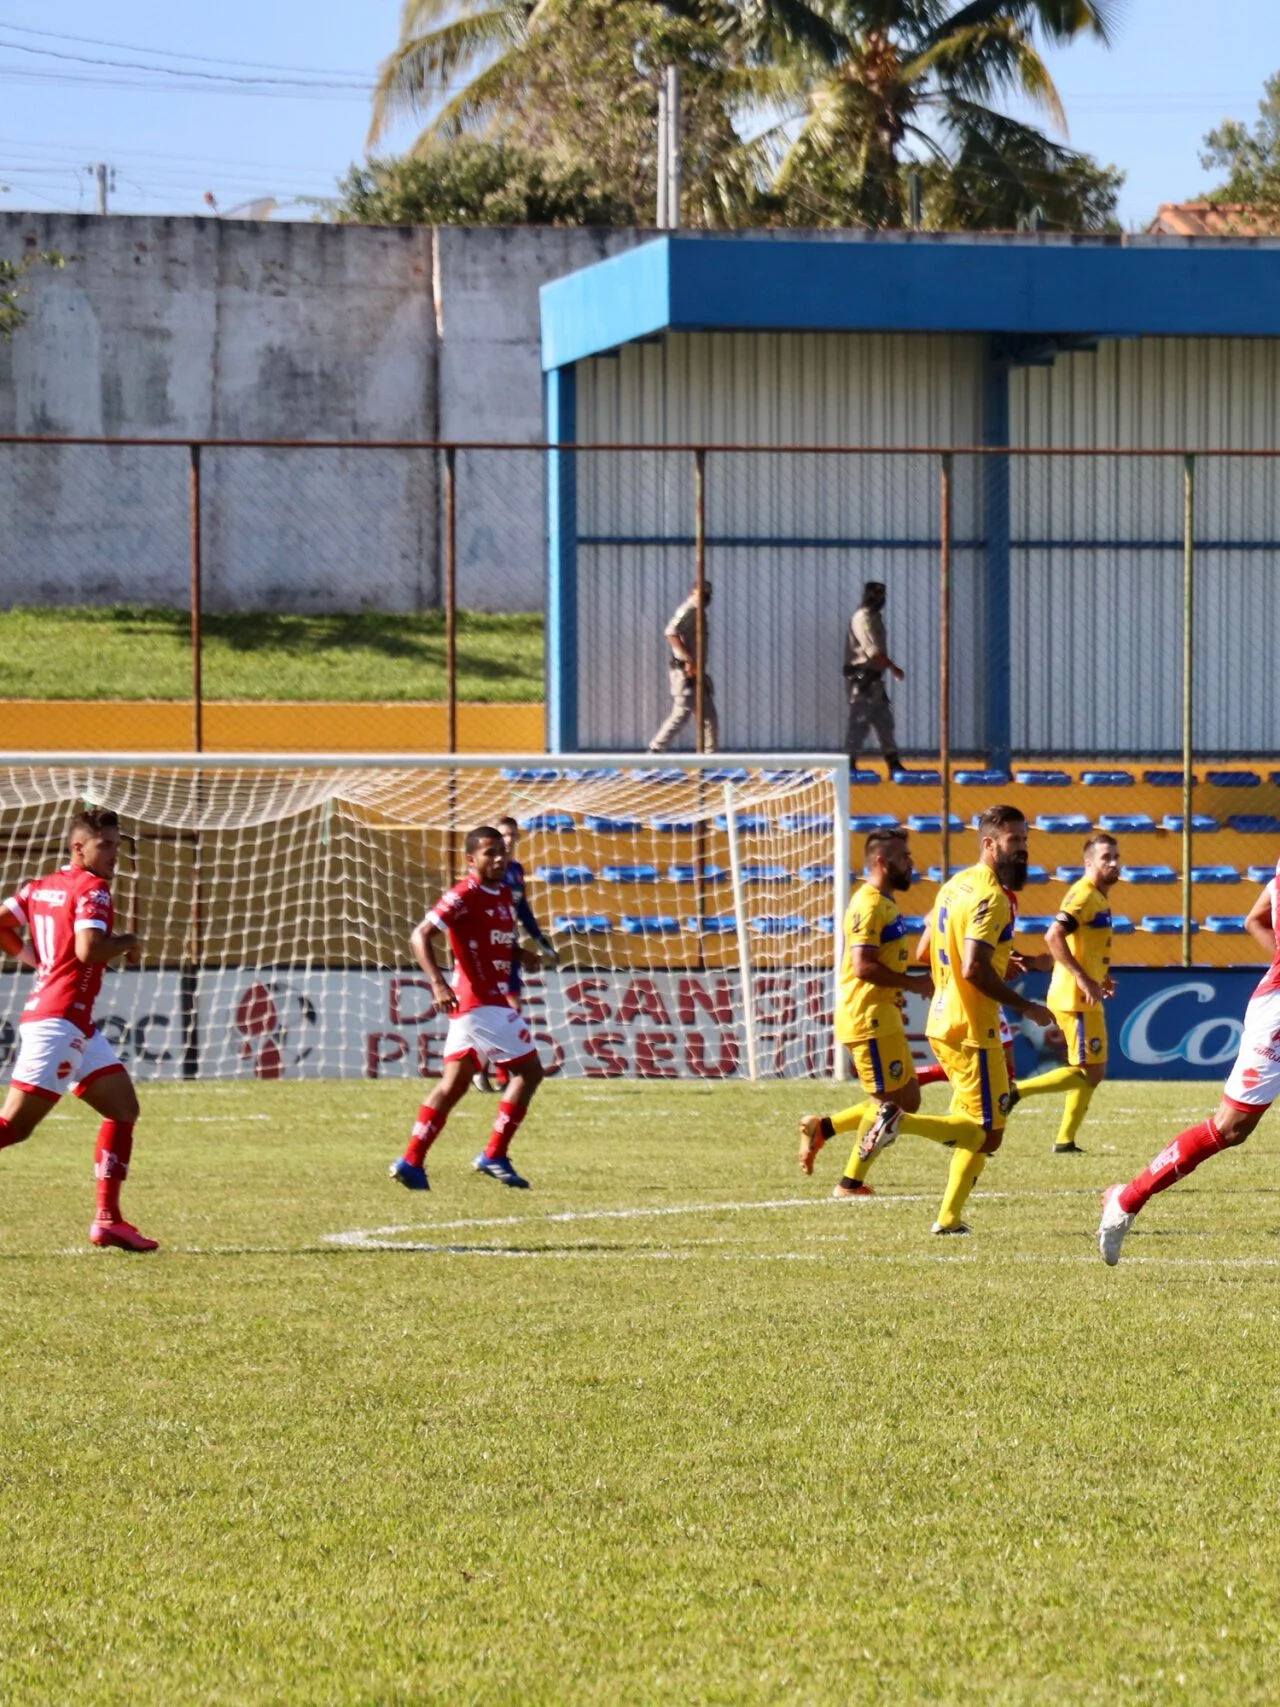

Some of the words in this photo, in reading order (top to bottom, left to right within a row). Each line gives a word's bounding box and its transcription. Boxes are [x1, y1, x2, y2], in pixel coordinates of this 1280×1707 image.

[32, 914, 56, 965] 11
[388, 977, 548, 1025] DE
[564, 977, 908, 1026] SANGU
[367, 1032, 566, 1079] PEO
[582, 1032, 741, 1079] SEU
